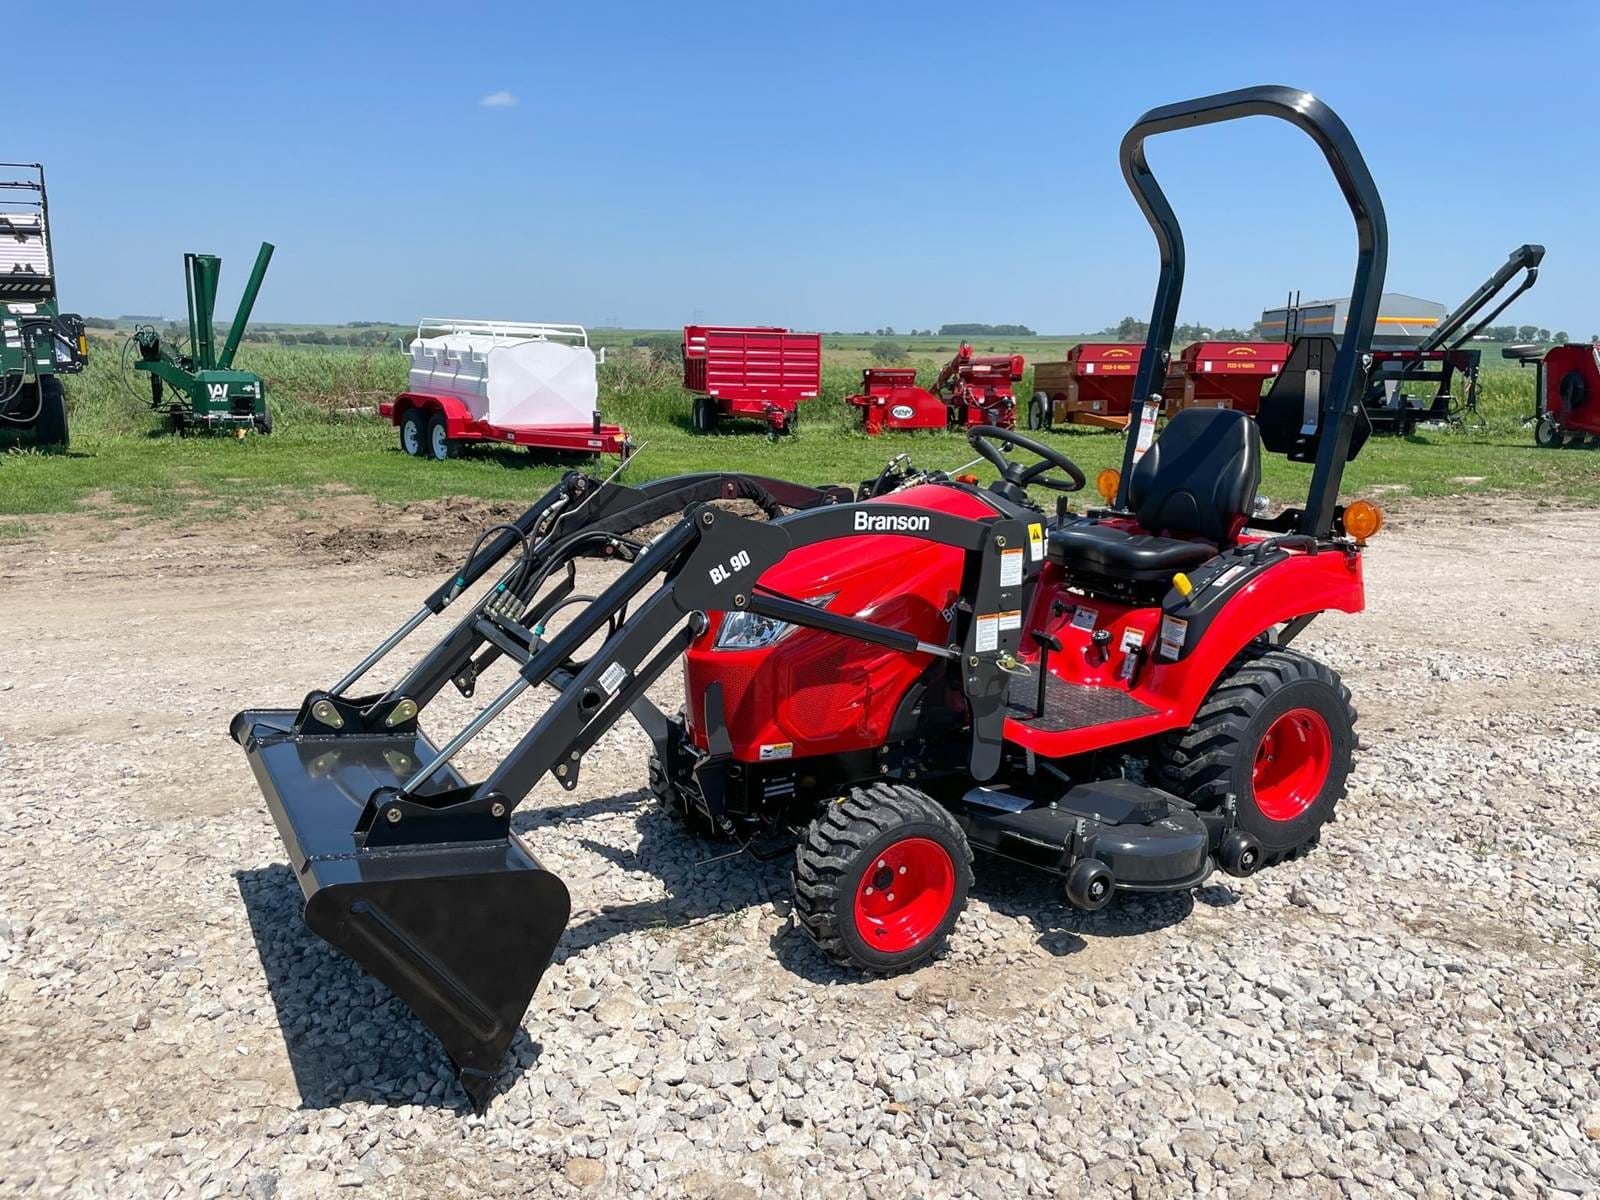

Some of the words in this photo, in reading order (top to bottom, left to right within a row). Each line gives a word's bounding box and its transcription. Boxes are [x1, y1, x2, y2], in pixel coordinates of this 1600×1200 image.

[854, 511, 930, 531] Branson
[709, 563, 731, 585] BL
[730, 550, 751, 572] 90
